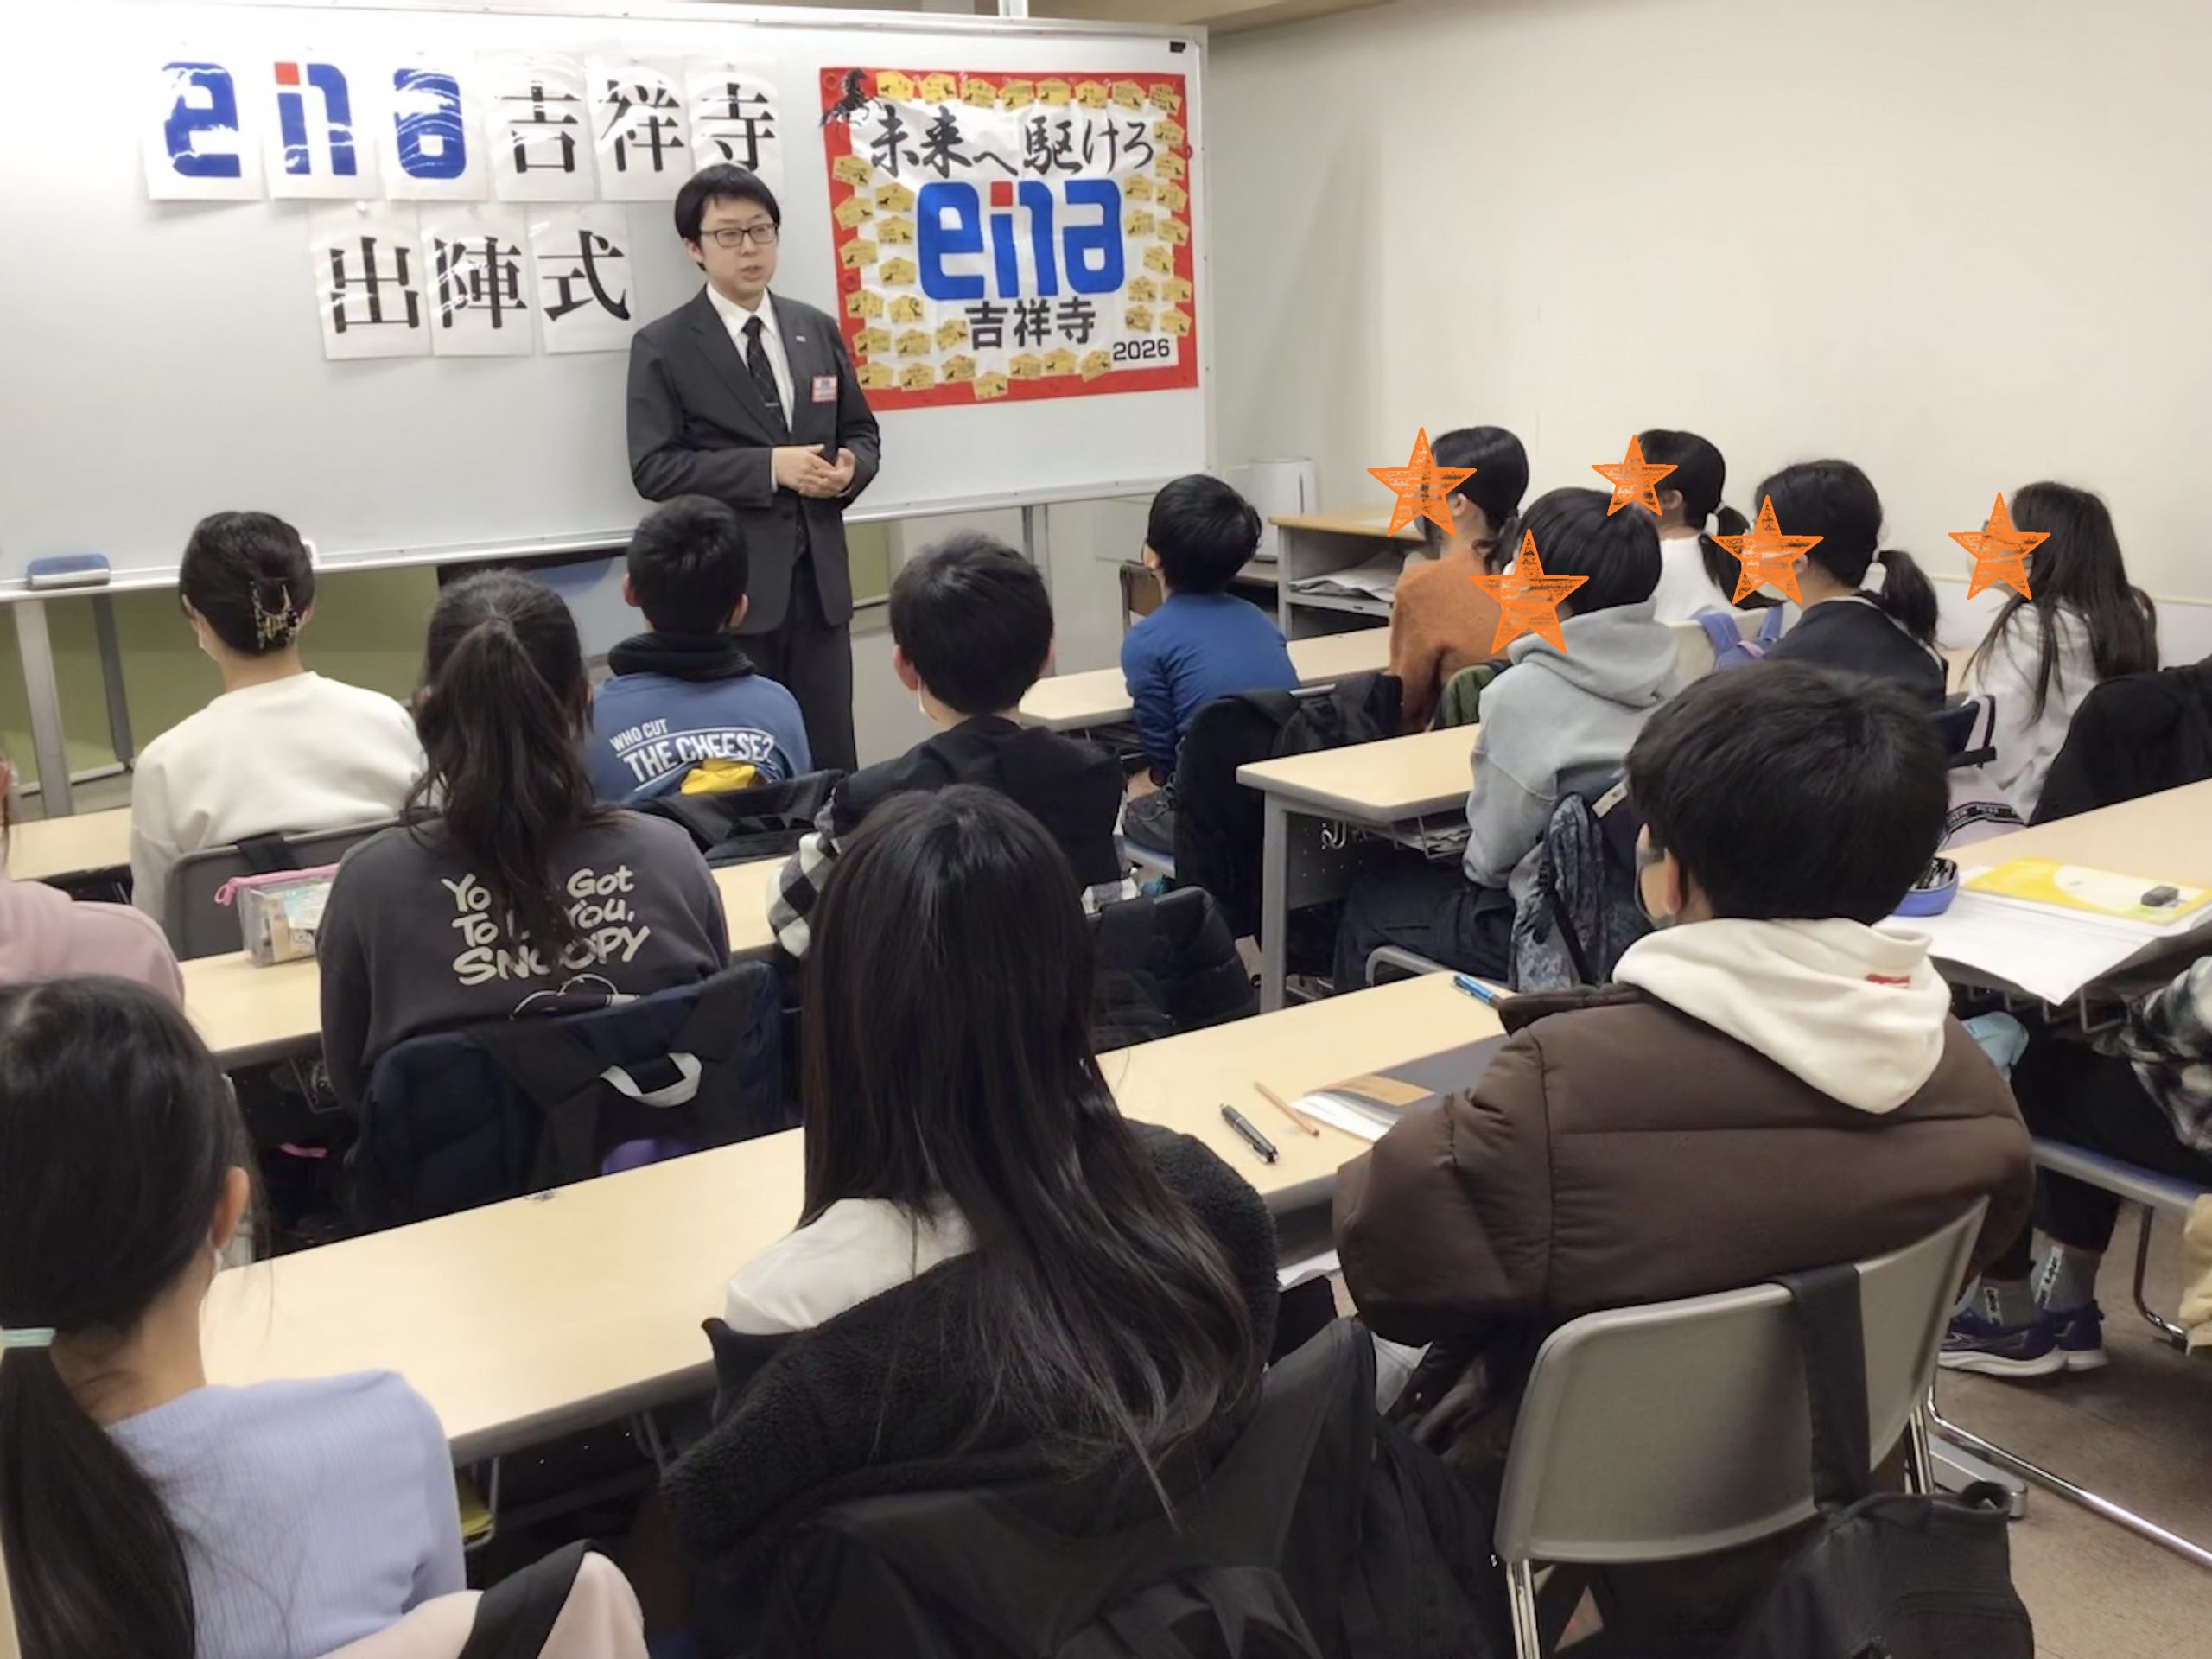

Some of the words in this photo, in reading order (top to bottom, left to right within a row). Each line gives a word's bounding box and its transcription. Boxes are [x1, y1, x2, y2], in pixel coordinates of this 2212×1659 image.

[498, 79, 776, 173] 吉祥寺
[870, 105, 1154, 178] 未来へ駆けろ
[329, 229, 631, 334] 出陣式
[964, 296, 1096, 349] 吉祥寺
[1113, 338, 1170, 361] 2026
[609, 726, 643, 752] WHO
[642, 718, 668, 738] CUT
[623, 741, 677, 783] THE
[676, 733, 775, 763] CHEESE?
[567, 865, 635, 898] Got
[451, 912, 499, 949] To
